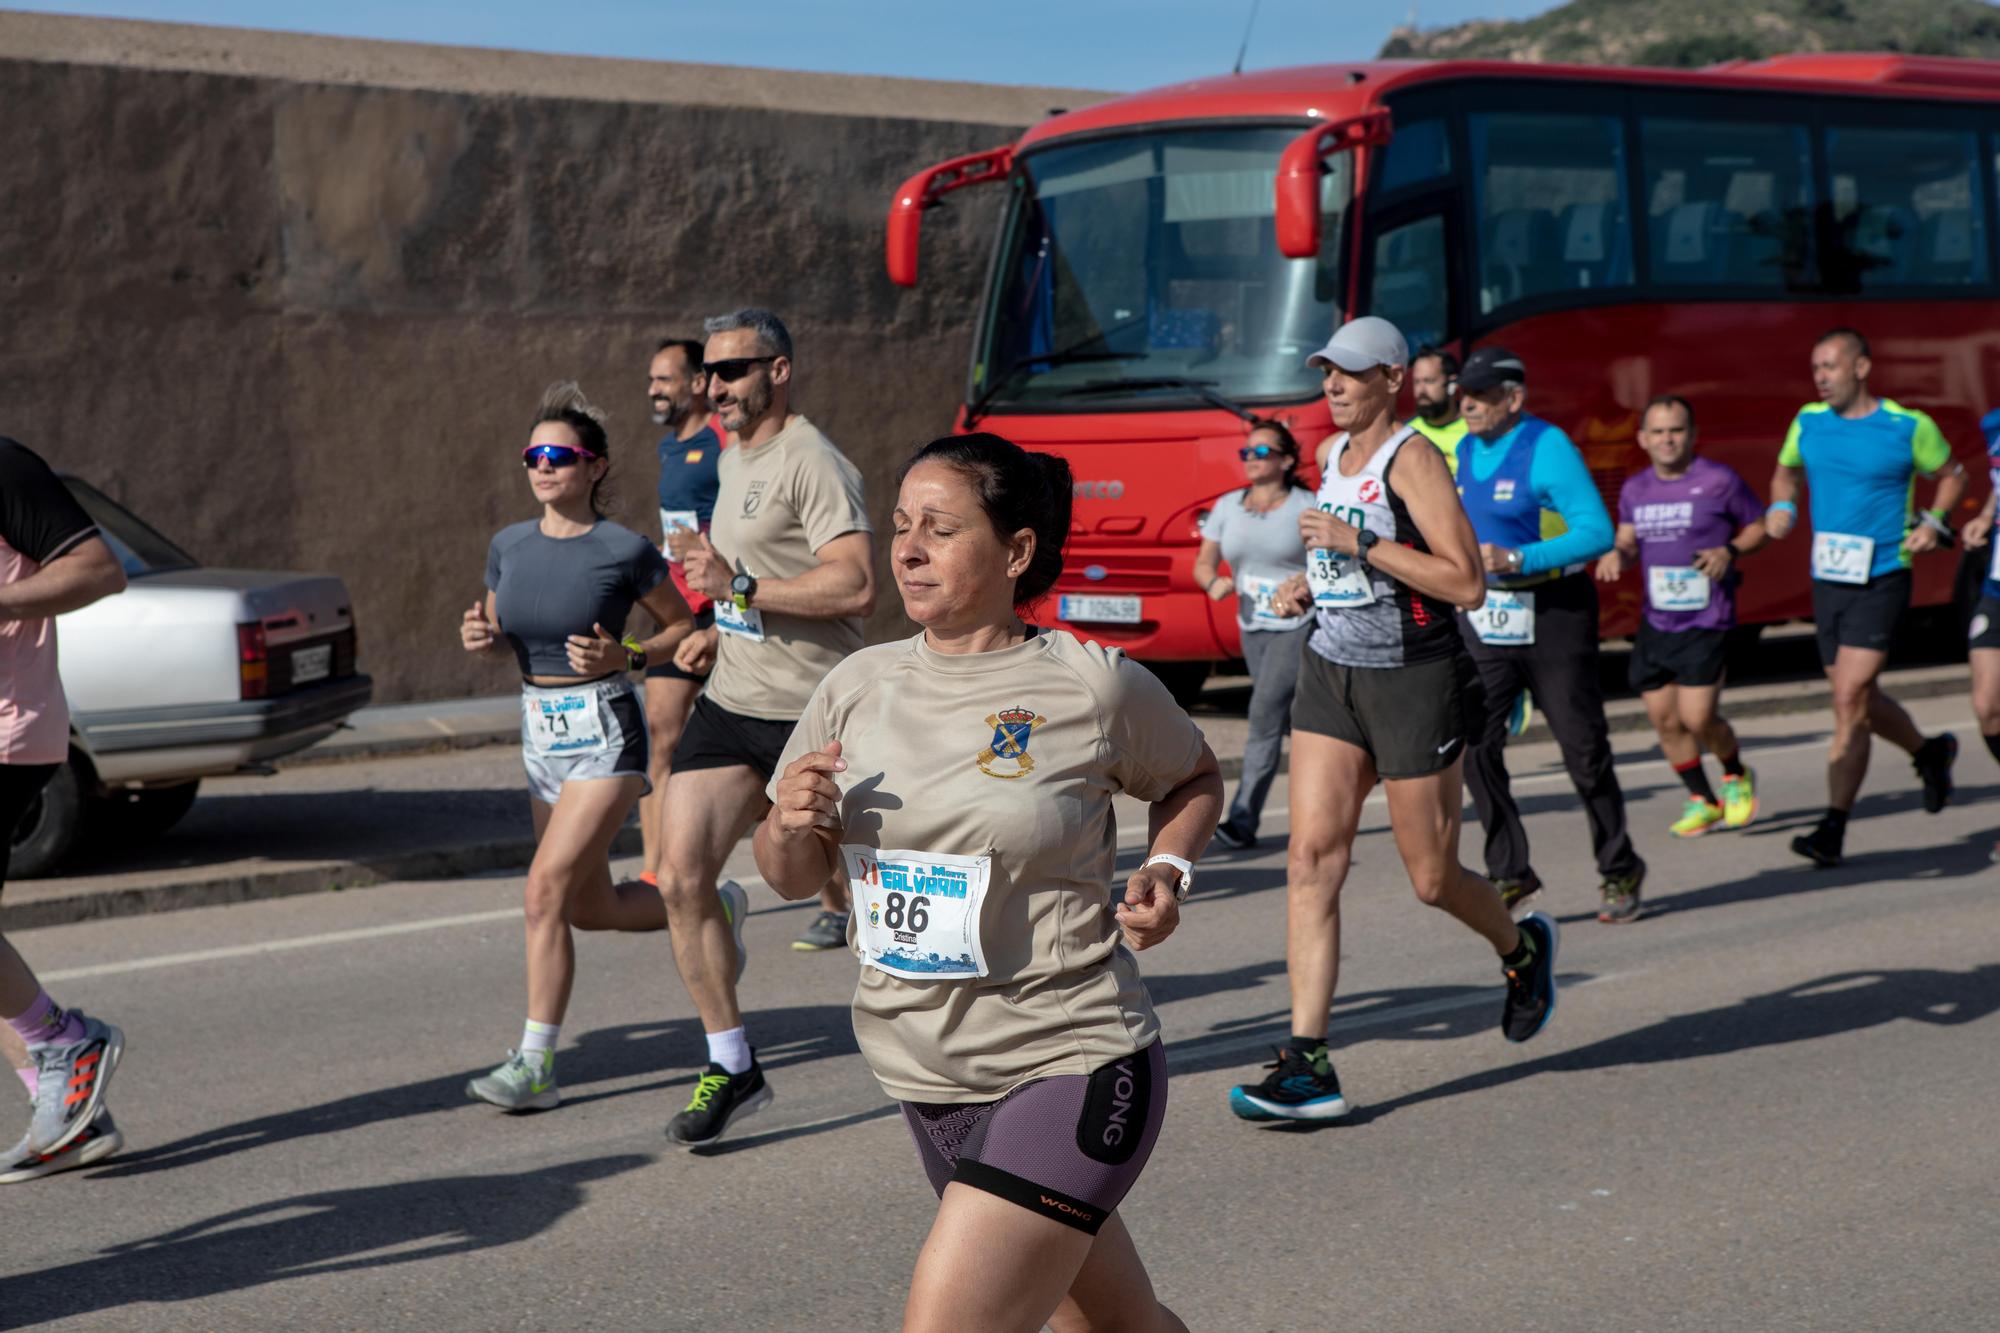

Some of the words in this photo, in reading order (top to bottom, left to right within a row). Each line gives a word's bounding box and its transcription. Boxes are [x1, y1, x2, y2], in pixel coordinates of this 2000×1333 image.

[1072, 479, 1124, 499] VECO
[1317, 561, 1342, 580] 35
[1488, 609, 1509, 626] 10
[544, 713, 569, 732] 71
[884, 892, 931, 934] 86
[1040, 1195, 1093, 1221] WONG
